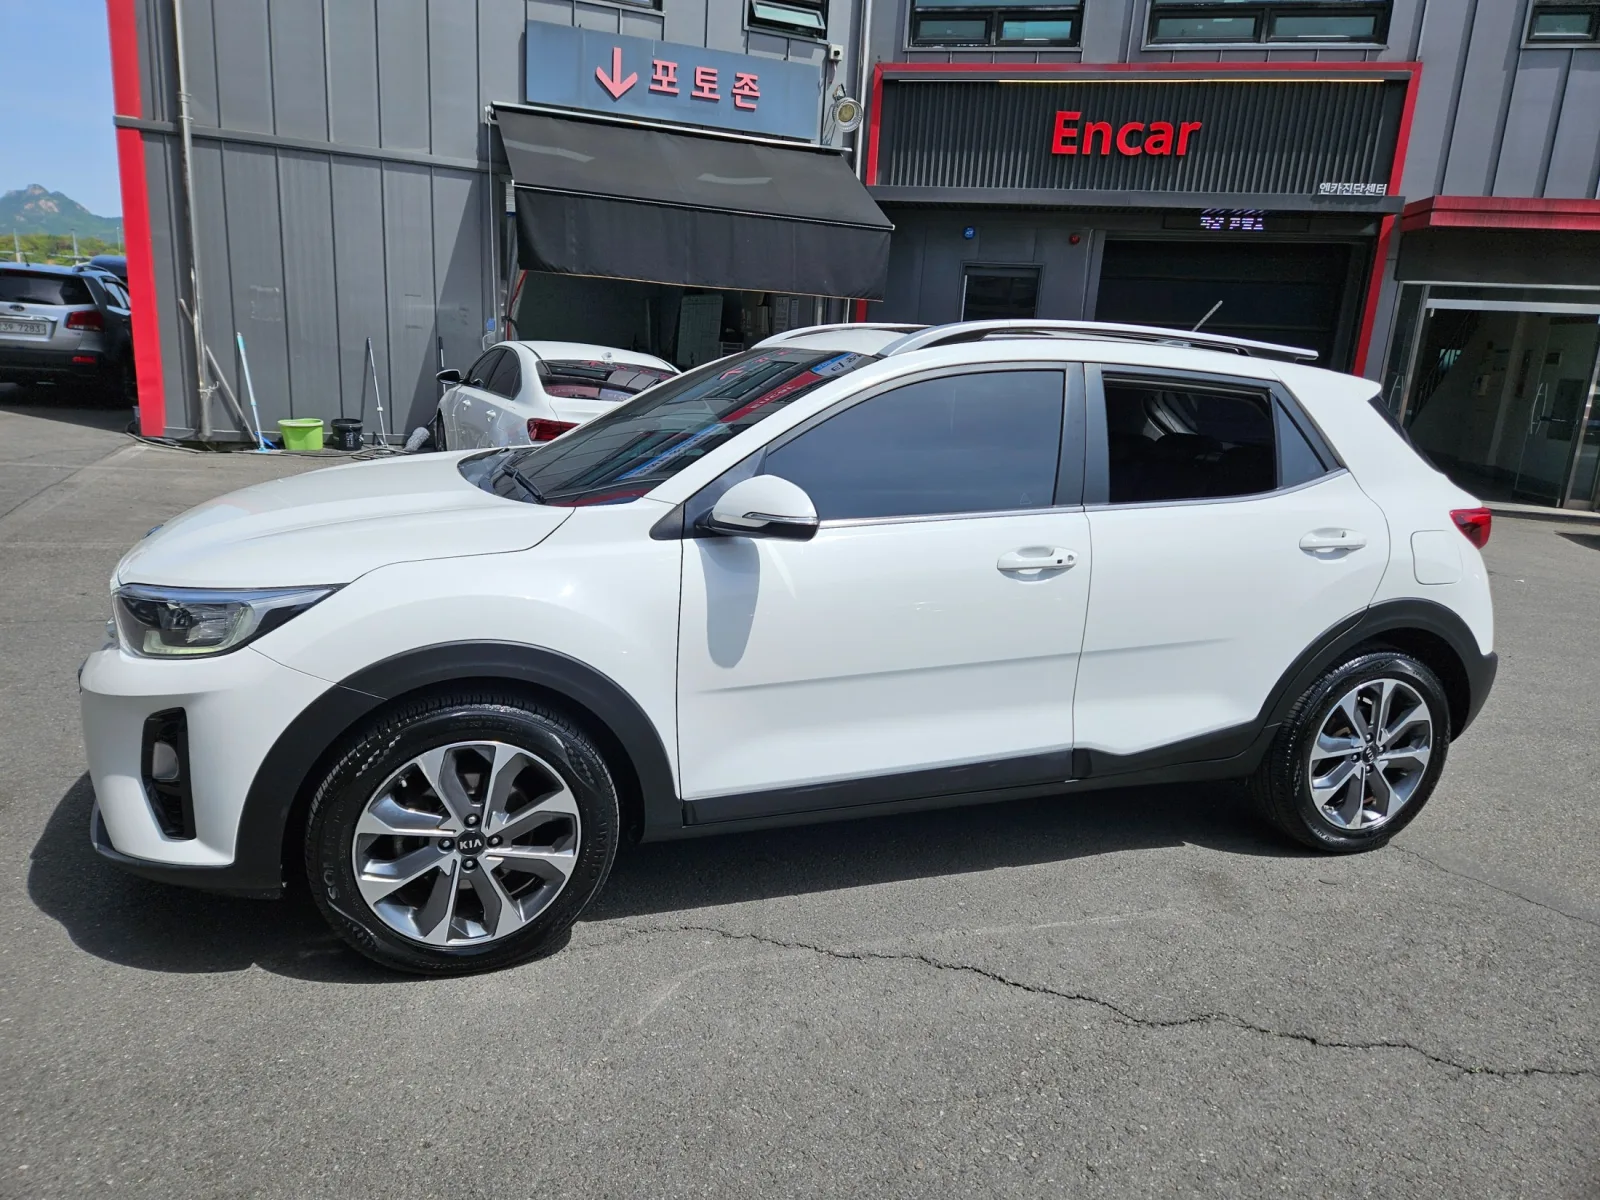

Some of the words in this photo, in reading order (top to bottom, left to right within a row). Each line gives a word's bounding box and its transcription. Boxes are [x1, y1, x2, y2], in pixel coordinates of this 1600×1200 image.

[649, 60, 760, 109] 포토존
[1051, 110, 1203, 156] Encar
[1319, 182, 1387, 196] 엔카진단센터
[459, 839, 482, 850] KIA
